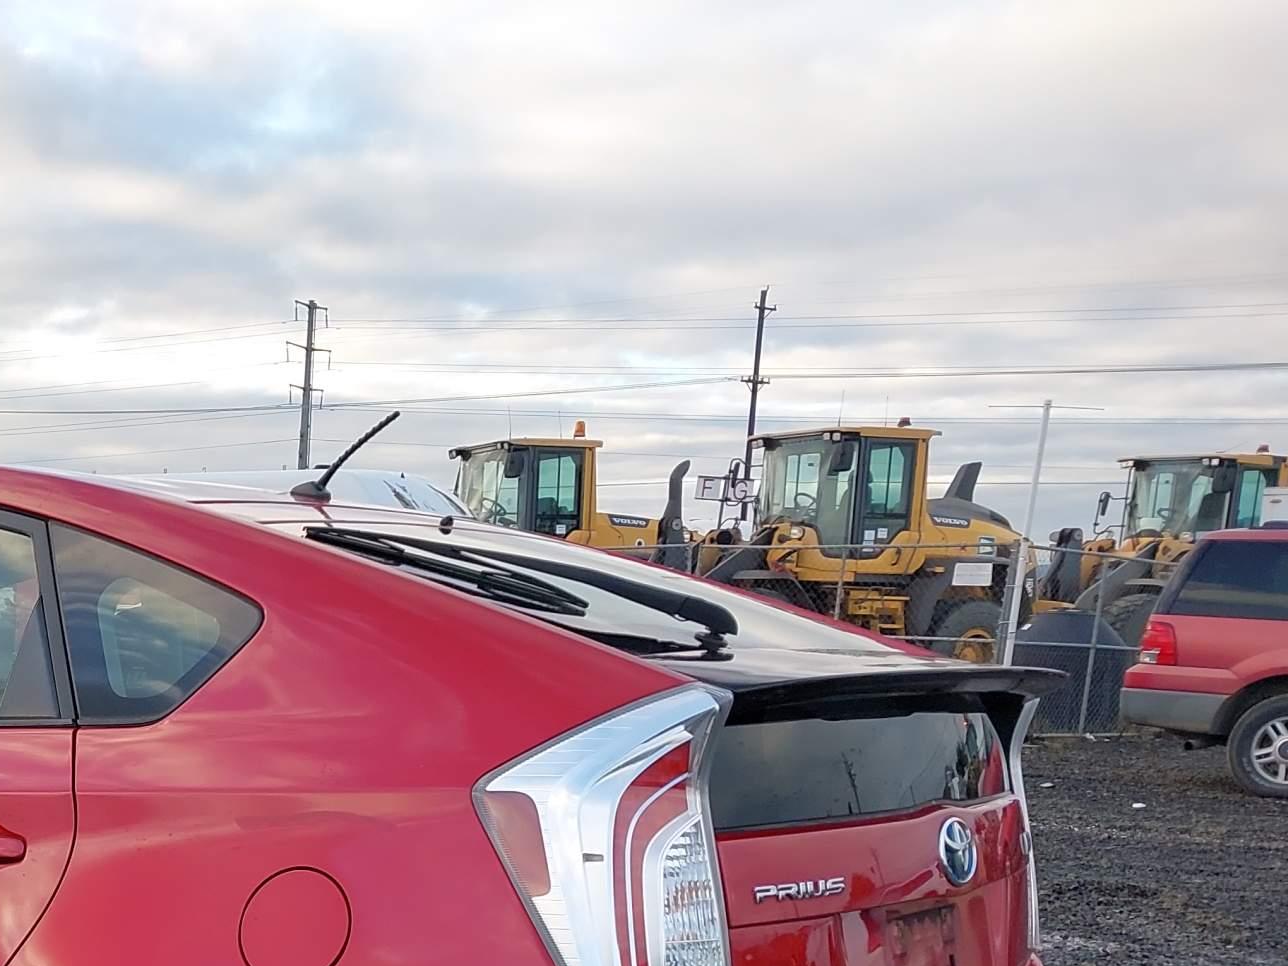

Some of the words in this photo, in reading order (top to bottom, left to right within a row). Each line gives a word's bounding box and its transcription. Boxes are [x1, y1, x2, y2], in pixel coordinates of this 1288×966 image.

[701, 478, 715, 498] F
[733, 480, 748, 501] G
[612, 517, 647, 526] VOLVO
[933, 516, 969, 526] VOLVO
[754, 876, 846, 904] PRIUS
